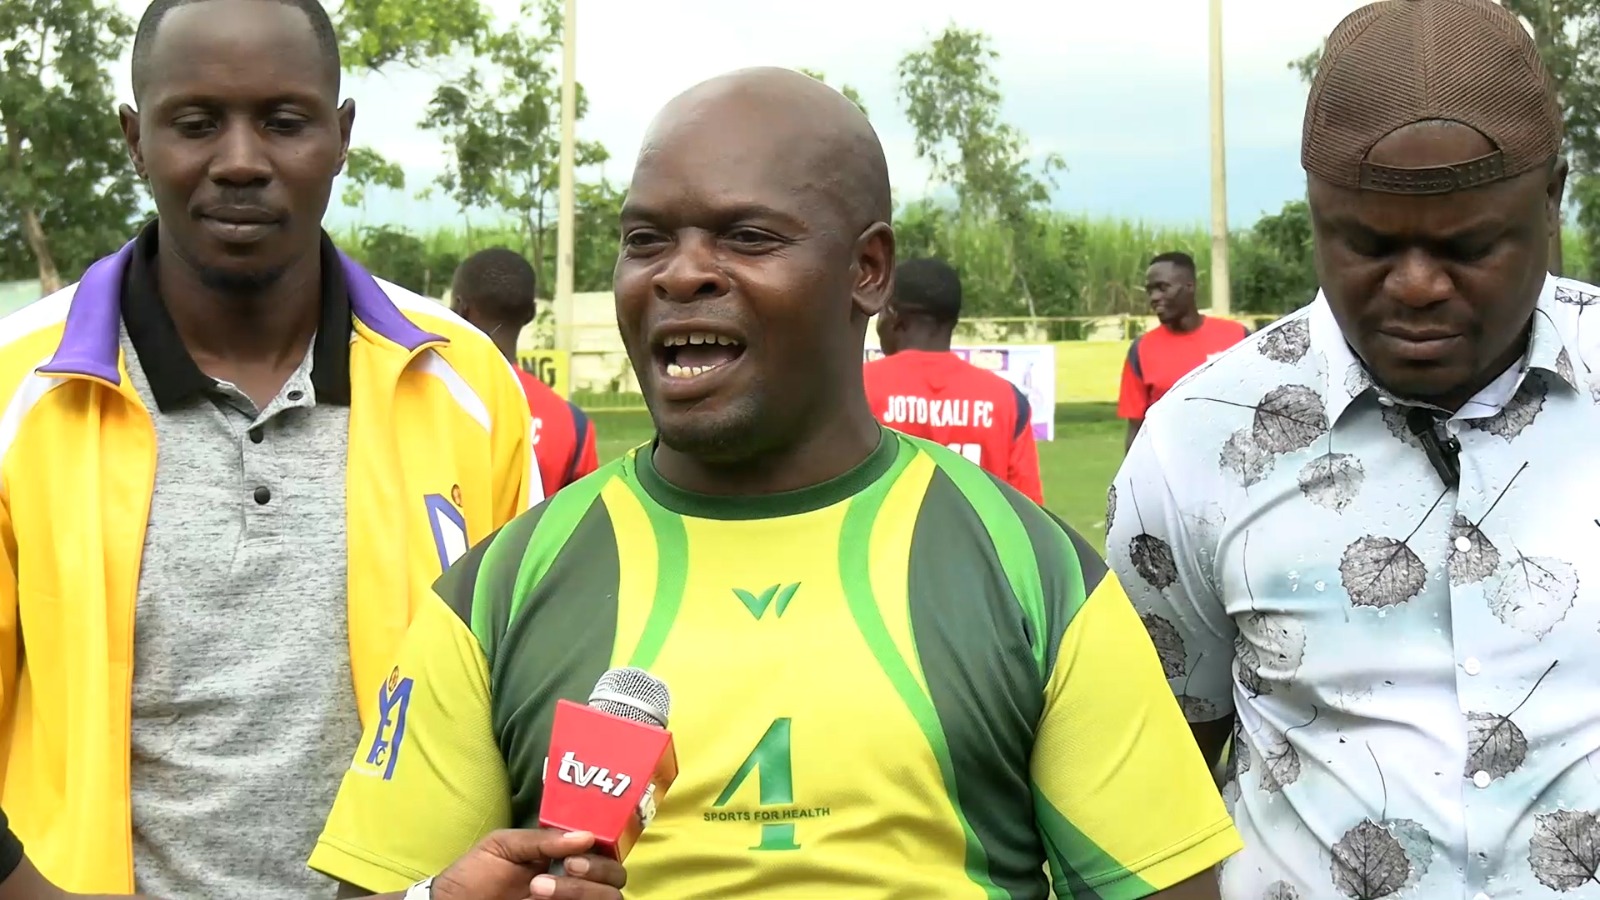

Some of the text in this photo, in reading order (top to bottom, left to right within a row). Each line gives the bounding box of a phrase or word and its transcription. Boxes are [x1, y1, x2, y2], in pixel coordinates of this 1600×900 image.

[883, 395, 994, 428] JOTO KALI FC
[558, 751, 632, 798] tv47
[703, 807, 831, 822] SPORTS FOR HEALTH
